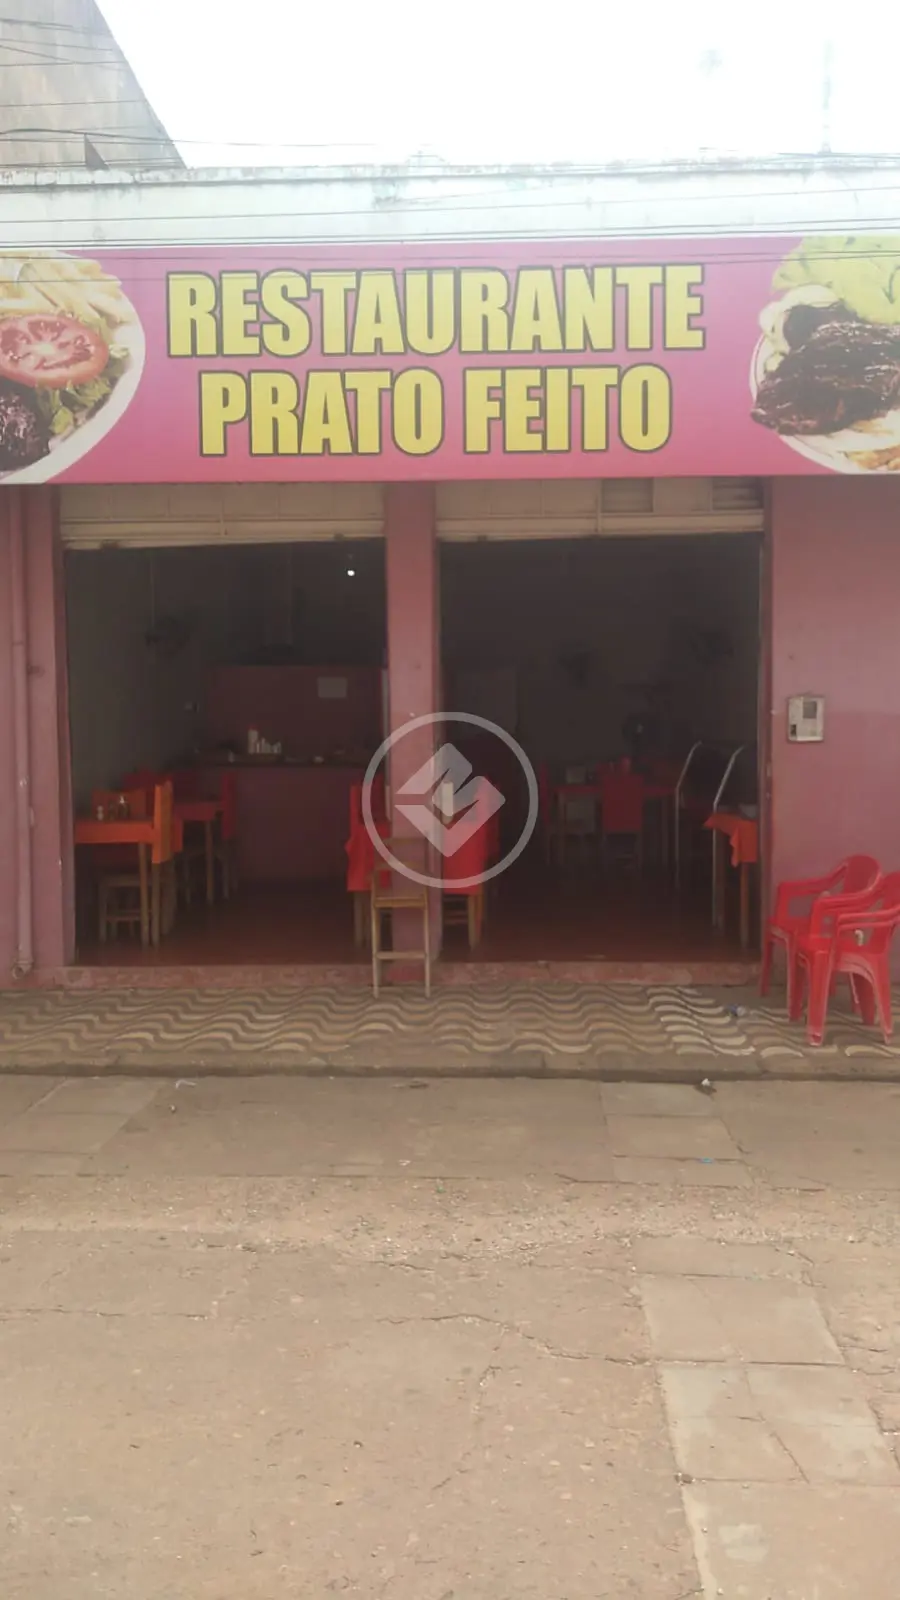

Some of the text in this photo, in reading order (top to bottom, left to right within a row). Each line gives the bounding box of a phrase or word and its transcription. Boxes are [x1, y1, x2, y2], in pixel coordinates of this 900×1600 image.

[167, 264, 706, 357] RESTAURANTE
[199, 363, 673, 457] PRATO FEITO
